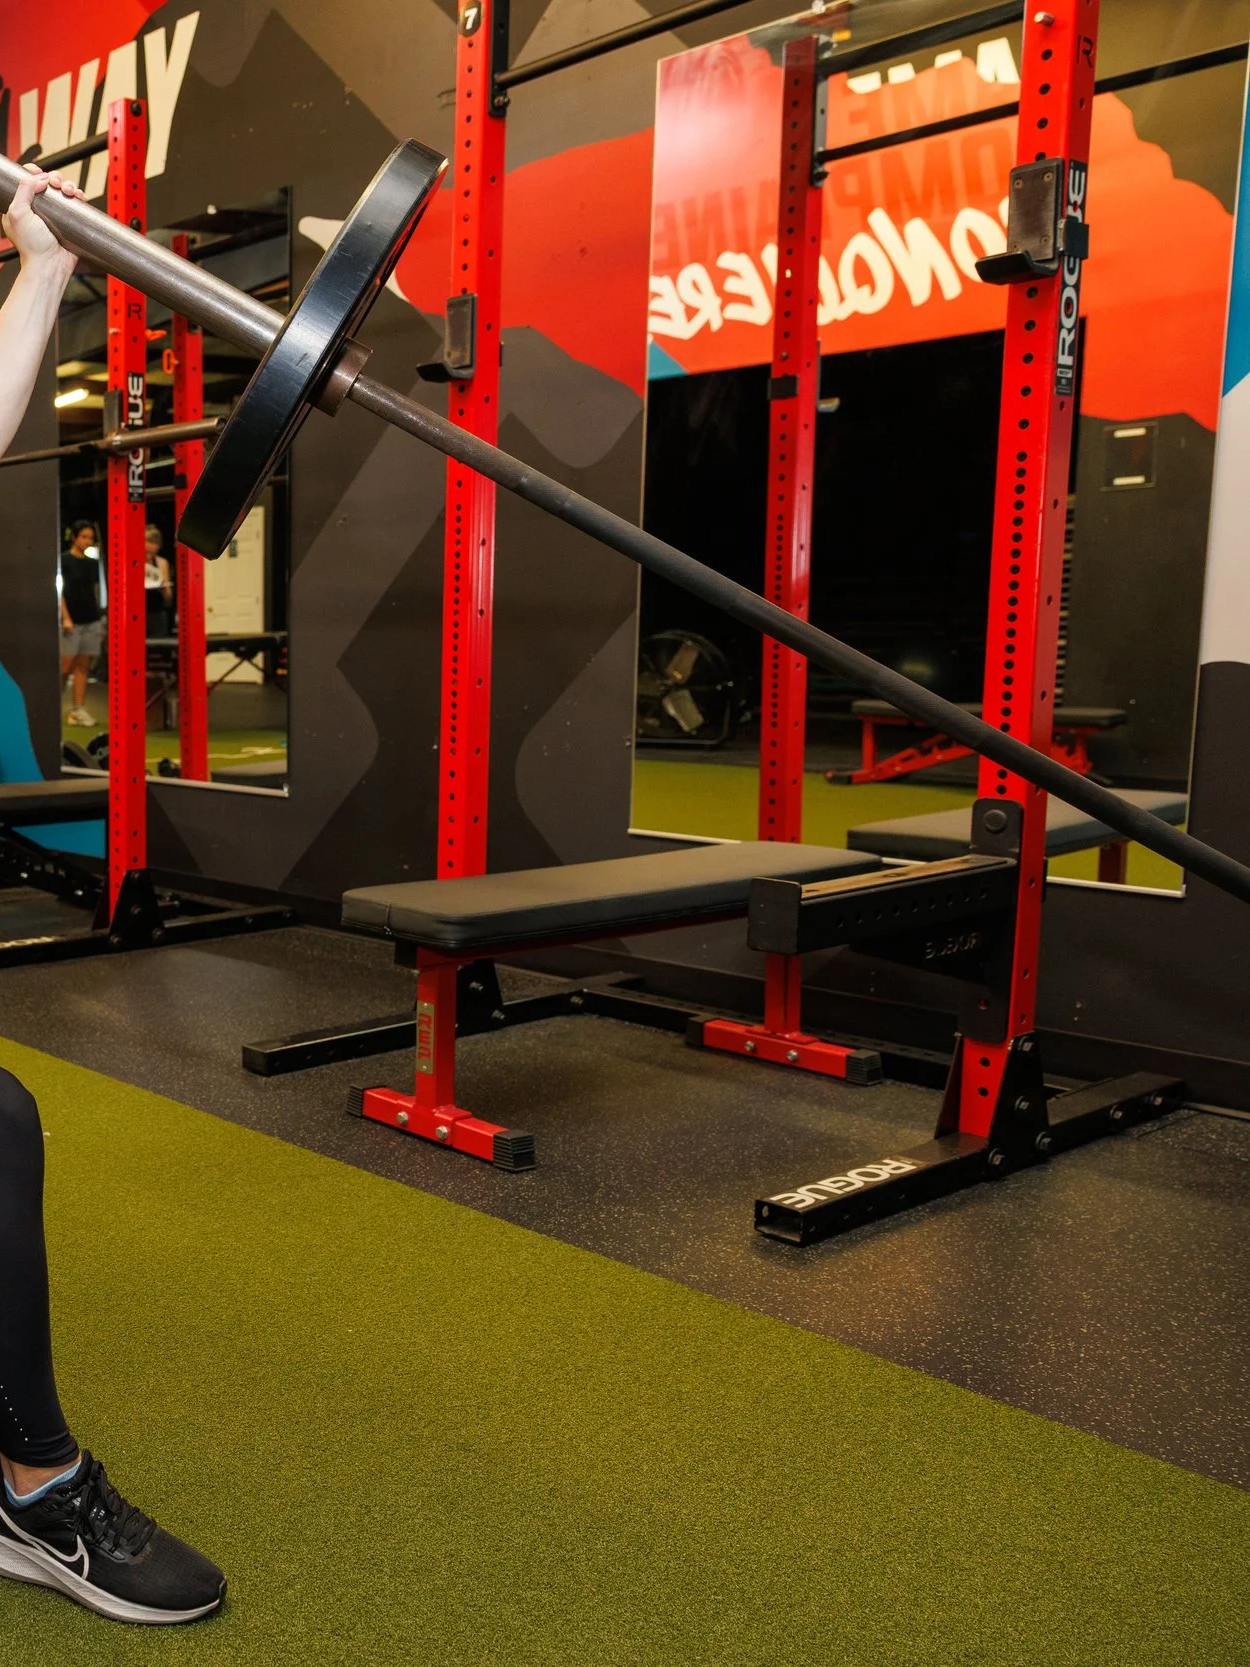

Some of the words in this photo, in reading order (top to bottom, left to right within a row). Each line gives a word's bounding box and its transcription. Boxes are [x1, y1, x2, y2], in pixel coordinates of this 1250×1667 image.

[464, 7, 478, 30] 7
[19, 10, 200, 202] WAY
[769, 1158, 918, 1209] ROGUE
